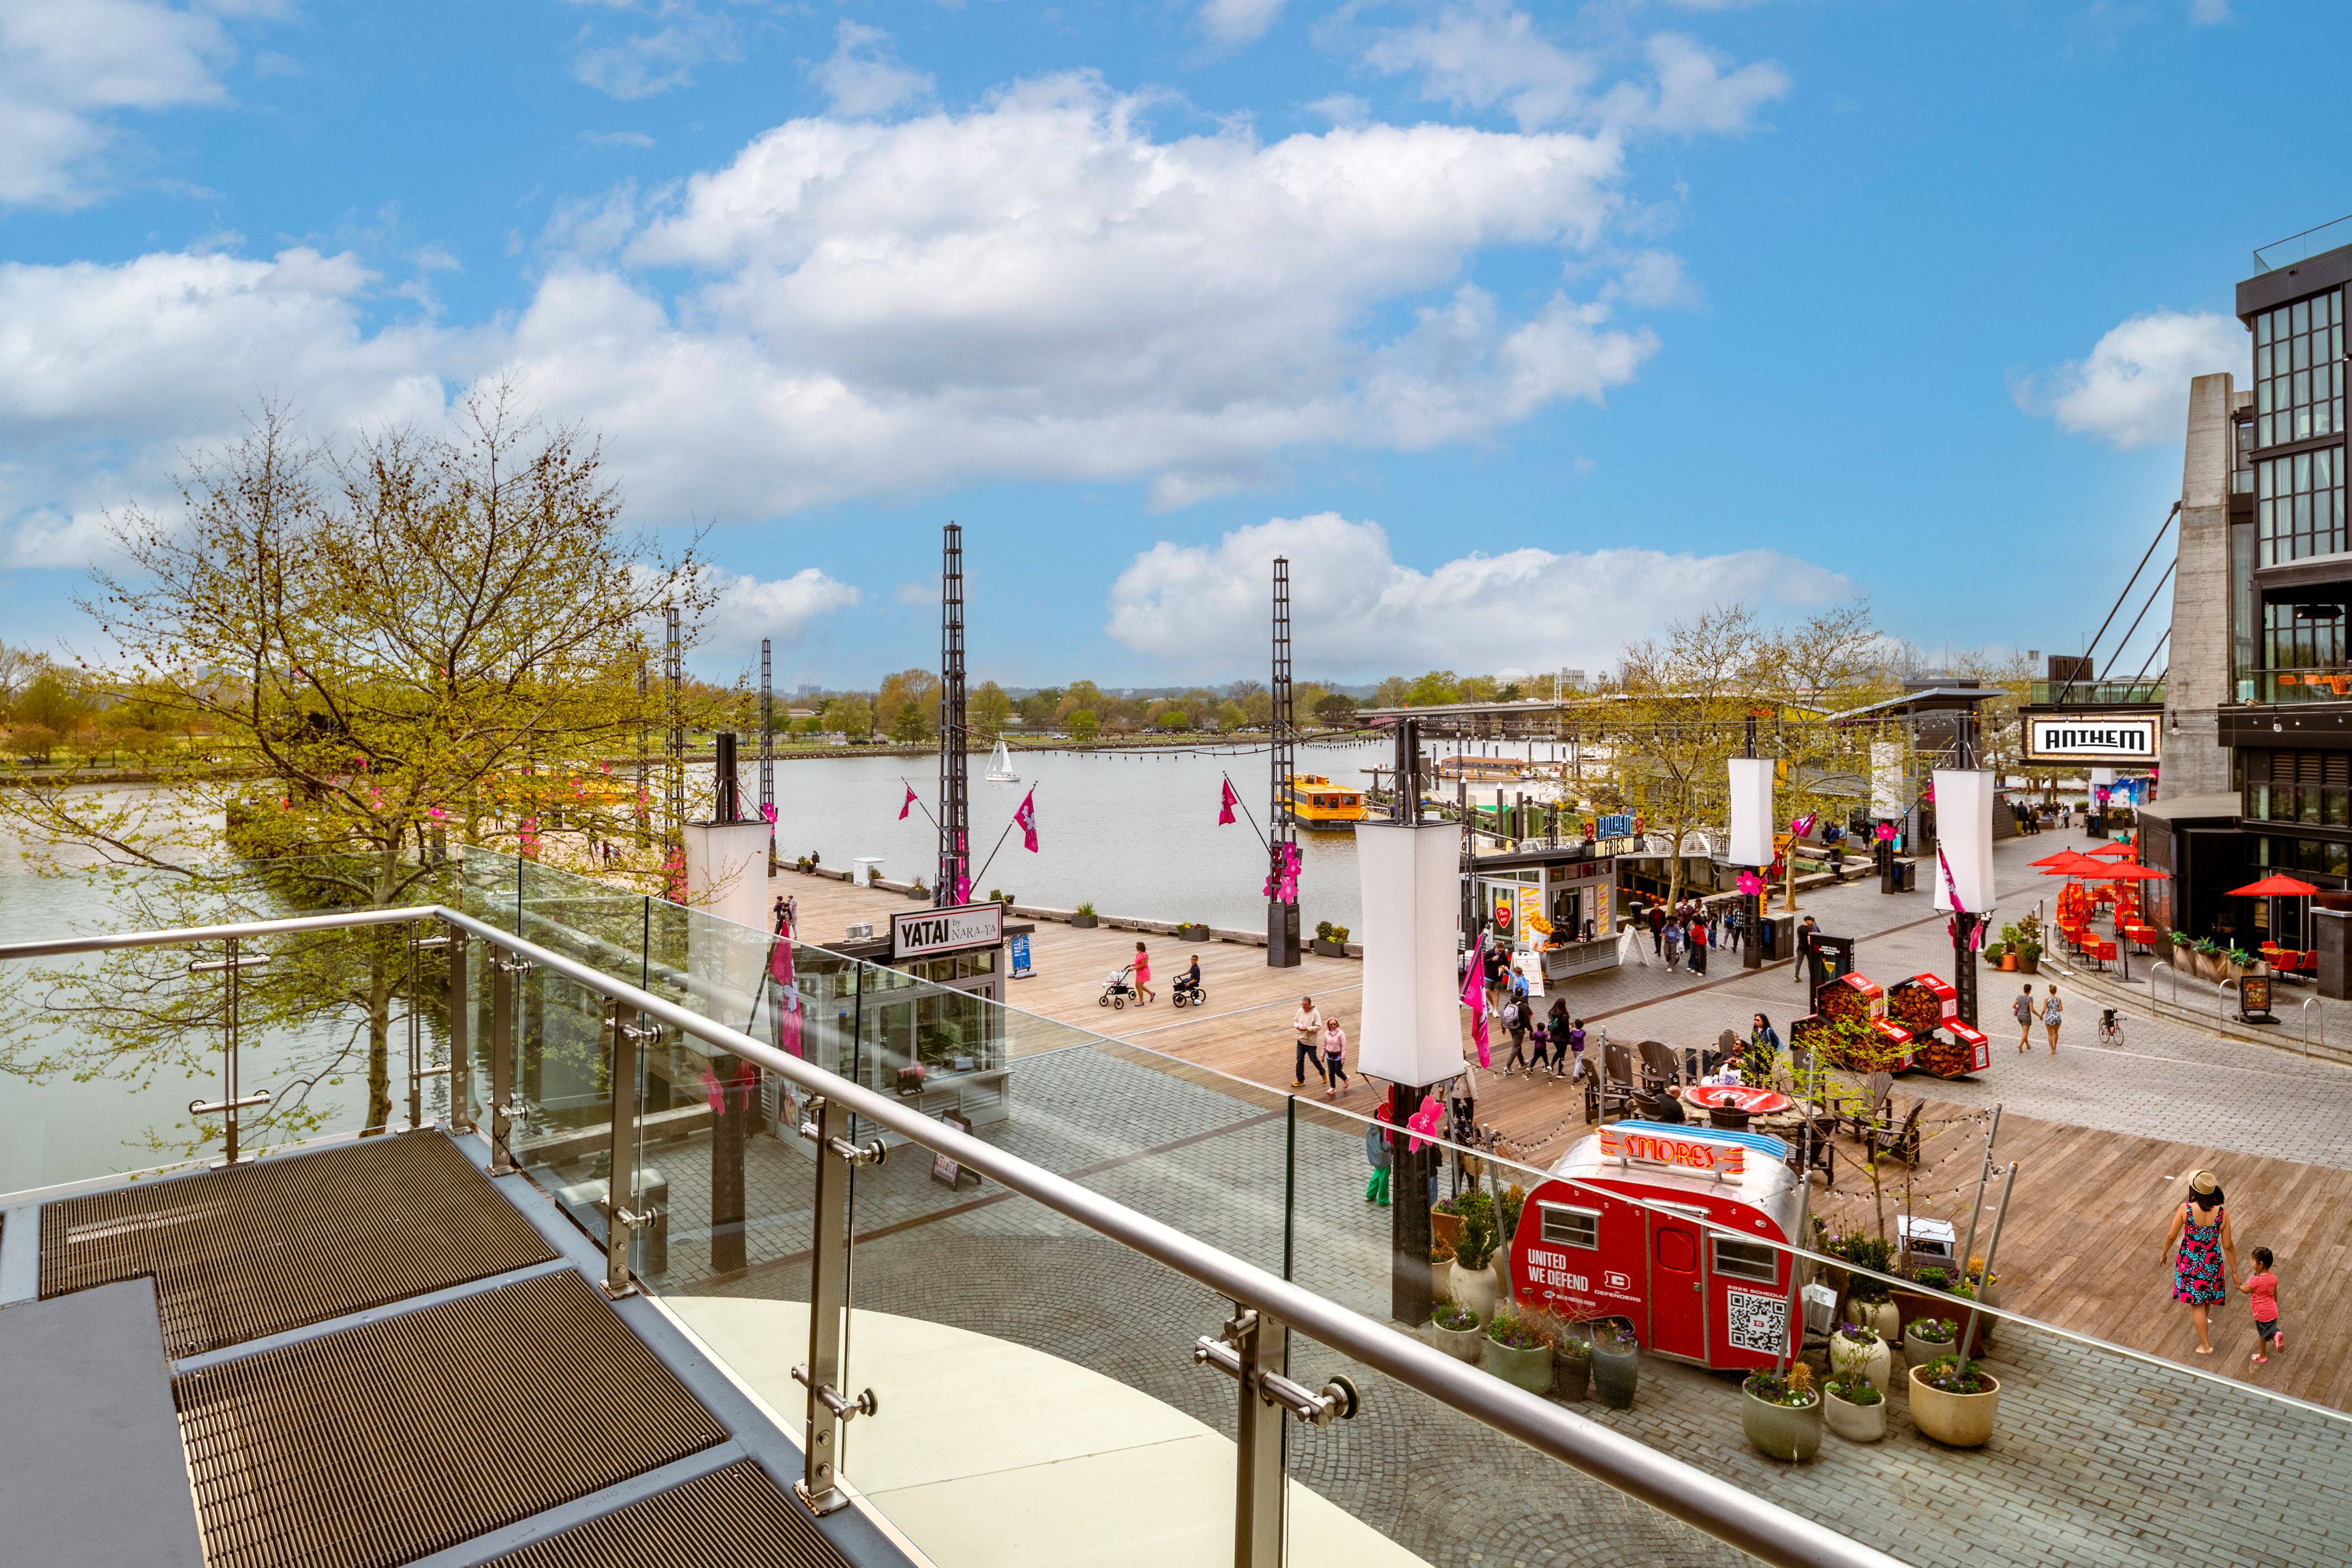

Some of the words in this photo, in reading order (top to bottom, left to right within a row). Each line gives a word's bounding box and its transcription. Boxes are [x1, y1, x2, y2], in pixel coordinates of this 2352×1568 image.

[2045, 730, 2144, 751] ANTHEM
[1599, 815, 1632, 840] ANTHEM
[1605, 839, 1625, 856] FRIES
[901, 919, 949, 948] YATAI
[952, 919, 961, 928] by
[952, 924, 997, 940] NARA-YA
[1624, 1135, 1714, 1170] S'MORES
[1527, 1248, 1567, 1270] UNITED
[1528, 1265, 1545, 1284] WE
[1547, 1269, 1588, 1292] DEFEND
[1594, 1289, 1641, 1303] DEFENDERS
